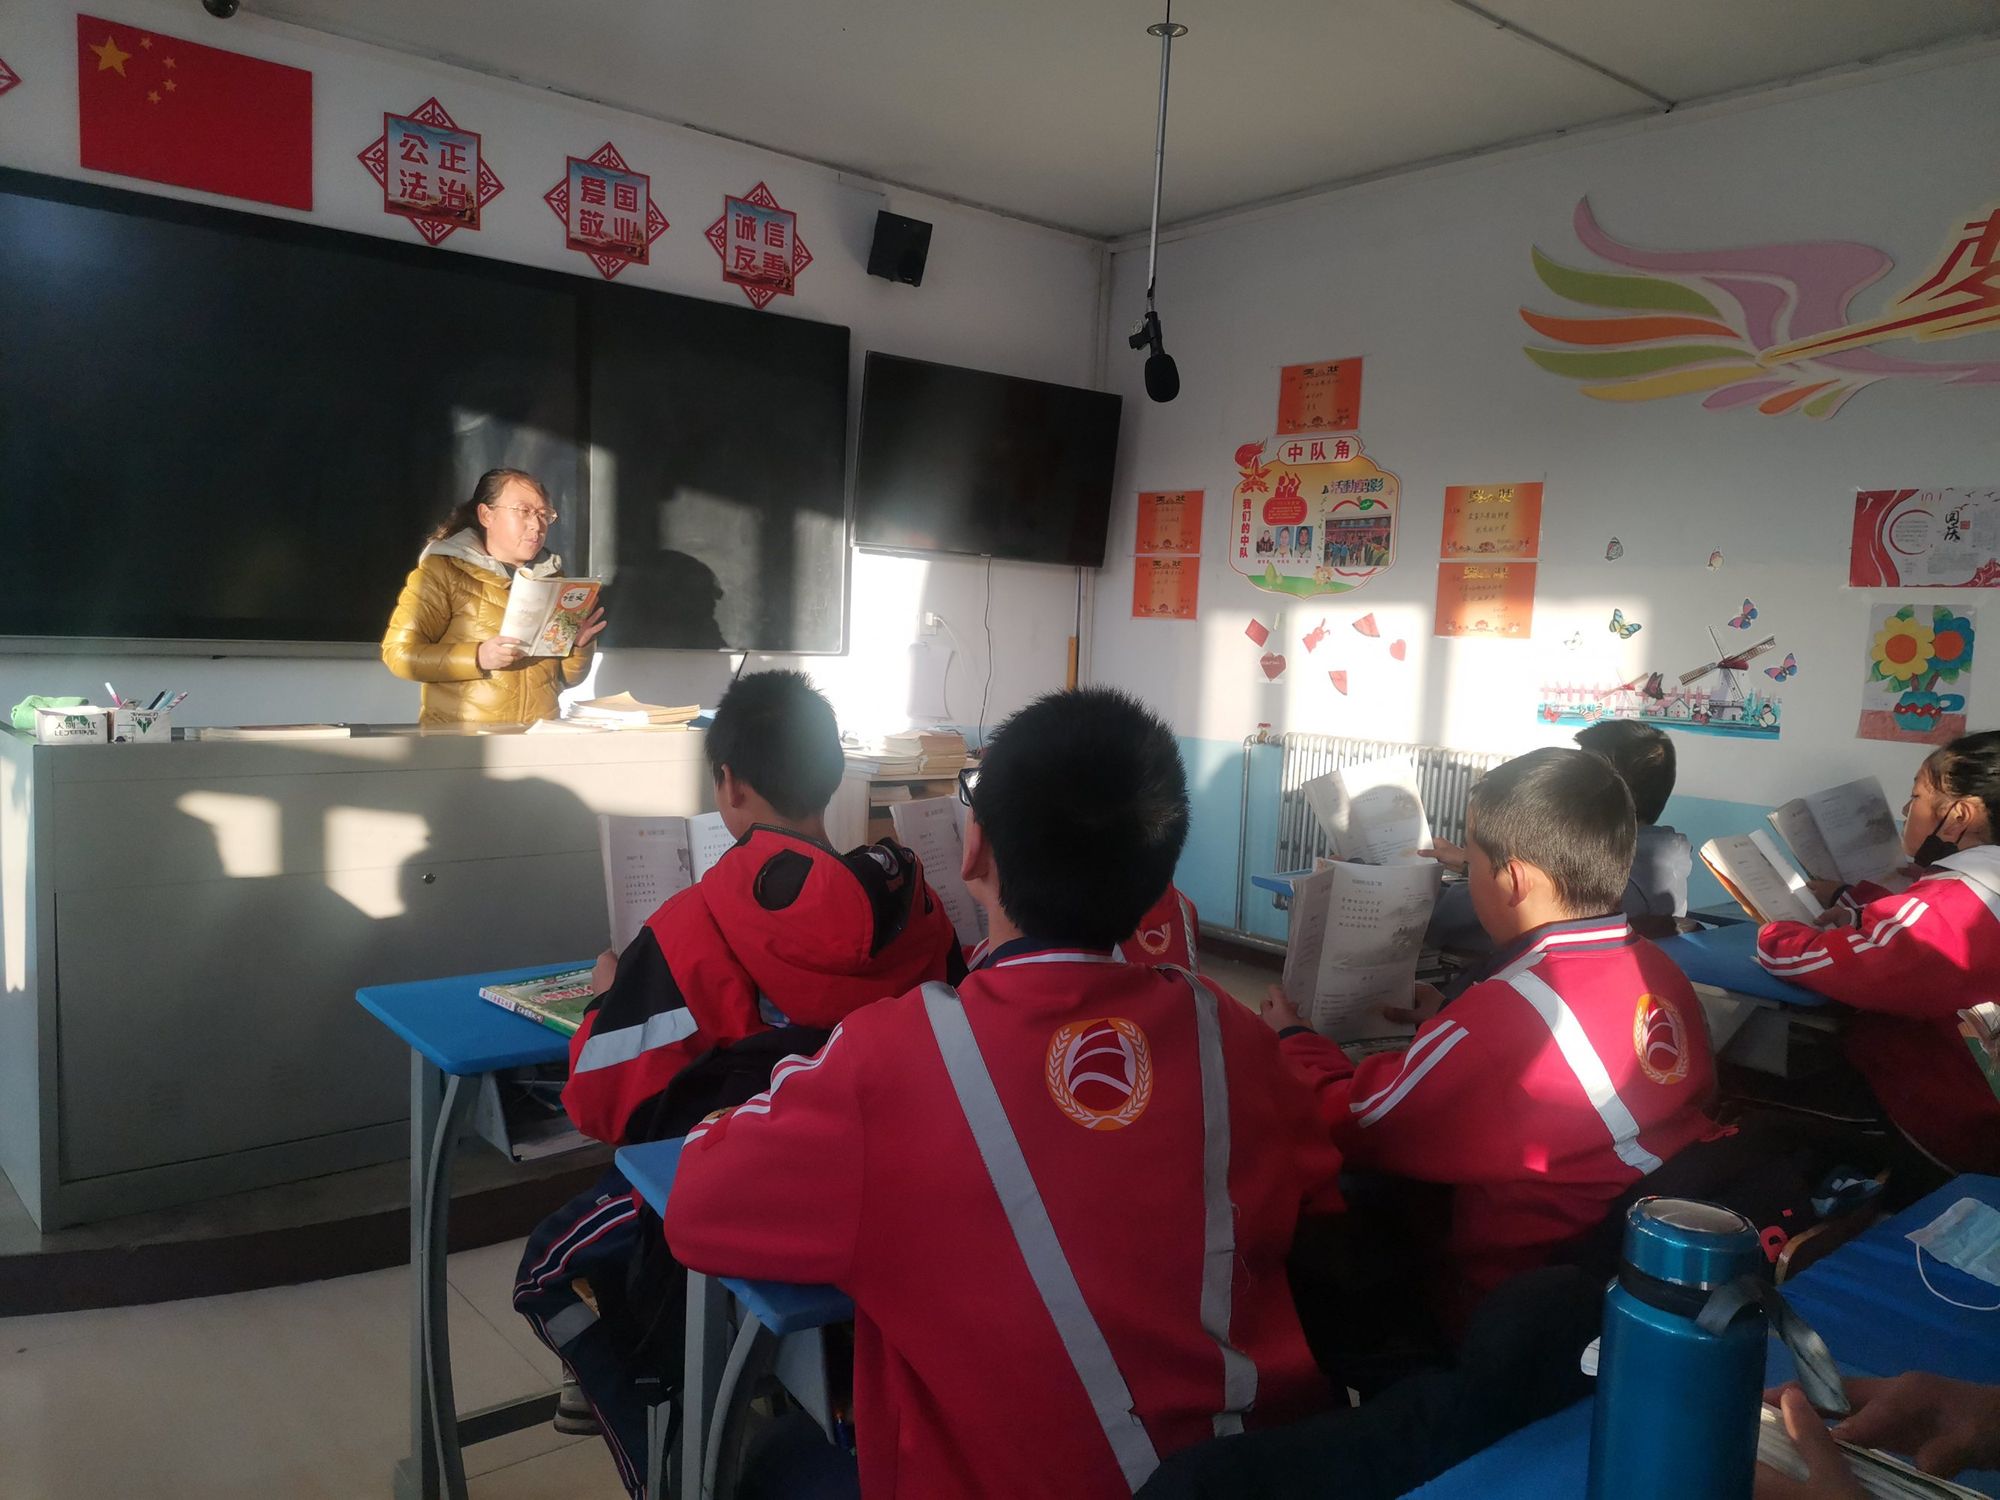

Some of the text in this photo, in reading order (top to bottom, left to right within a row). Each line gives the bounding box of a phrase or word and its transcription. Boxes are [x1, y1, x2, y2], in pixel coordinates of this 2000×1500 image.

[399, 132, 466, 174] 公正
[399, 169, 466, 210] 法治
[580, 175, 638, 213] 爱国
[579, 208, 641, 245] 敬业
[735, 212, 785, 248] 诚信
[733, 245, 784, 281] 友善
[1288, 440, 1350, 462] 中队角
[1239, 498, 1252, 558] 我们的中队
